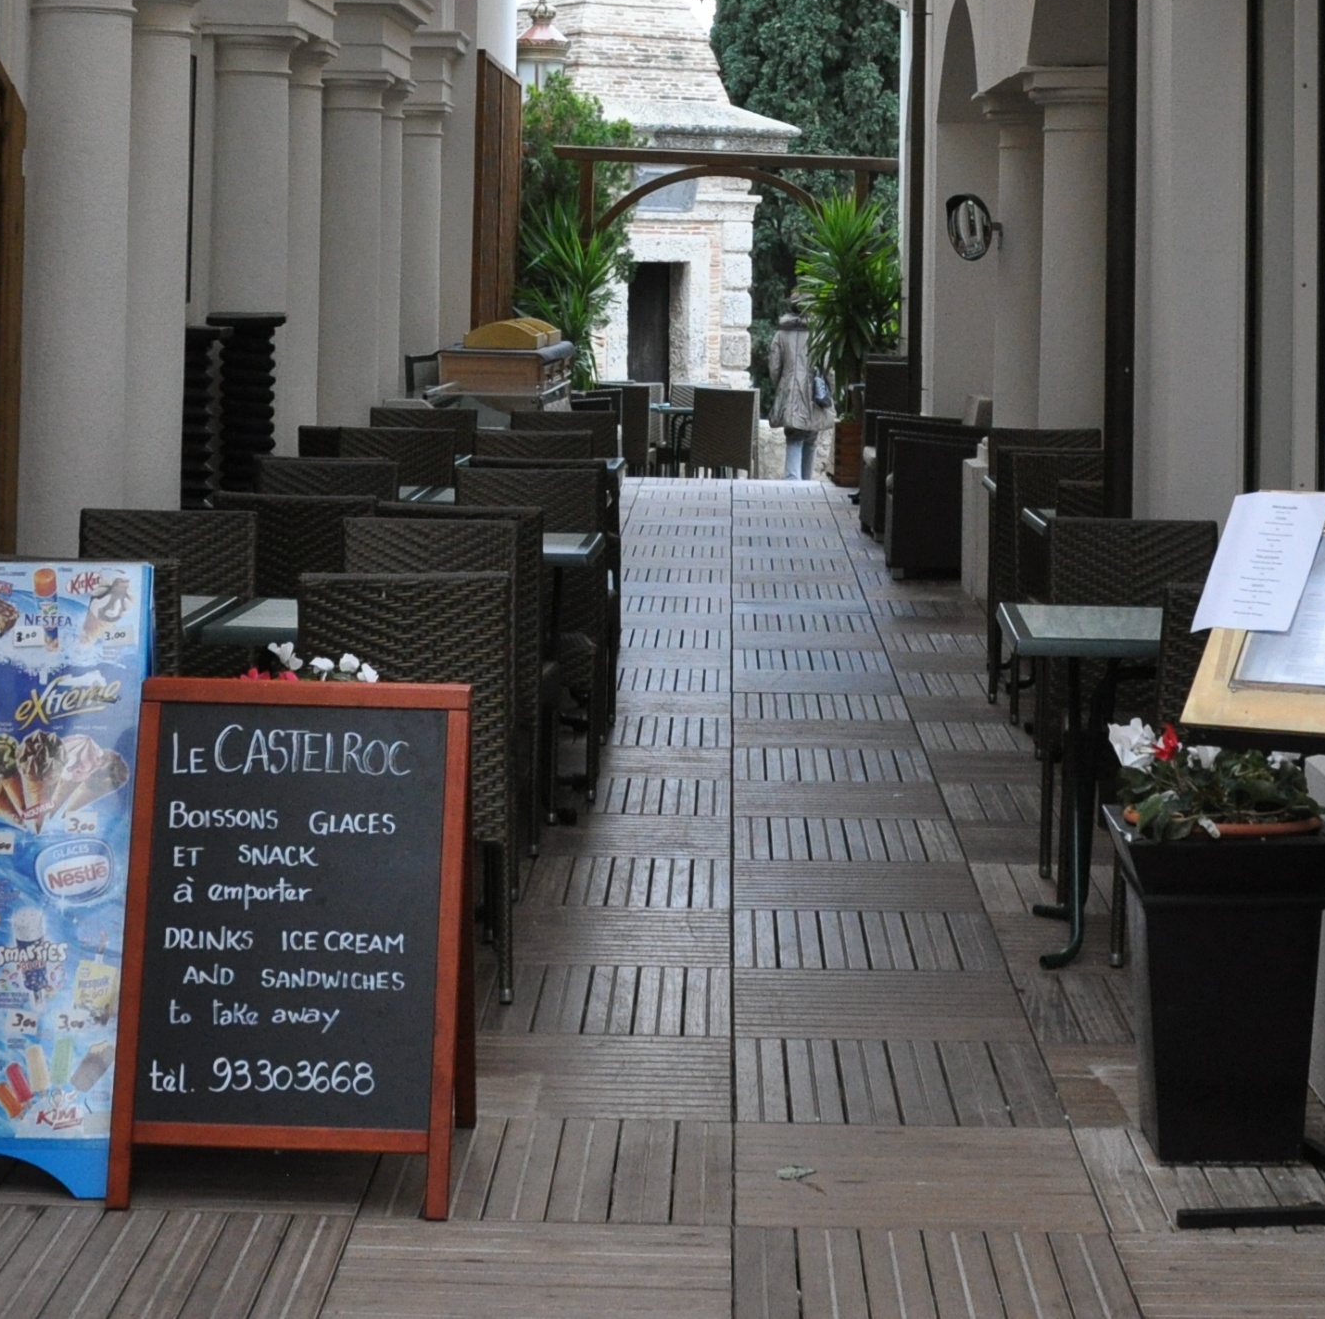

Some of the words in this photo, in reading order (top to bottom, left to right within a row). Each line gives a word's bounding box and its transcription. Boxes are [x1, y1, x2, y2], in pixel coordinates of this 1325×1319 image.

[24, 613, 73, 627] NESTEA
[214, 724, 411, 776] CASTELROC
[309, 811, 396, 835] GLACES
[174, 846, 204, 867] ET
[238, 844, 319, 866] SNACK
[164, 926, 253, 951] DRINKS
[282, 931, 319, 951] ICE
[324, 931, 404, 954] CREAM
[183, 964, 234, 985] AND
[261, 968, 405, 991] SANDWICHES
[272, 1008, 340, 1033] away
[209, 1057, 375, 1095] 93303668
